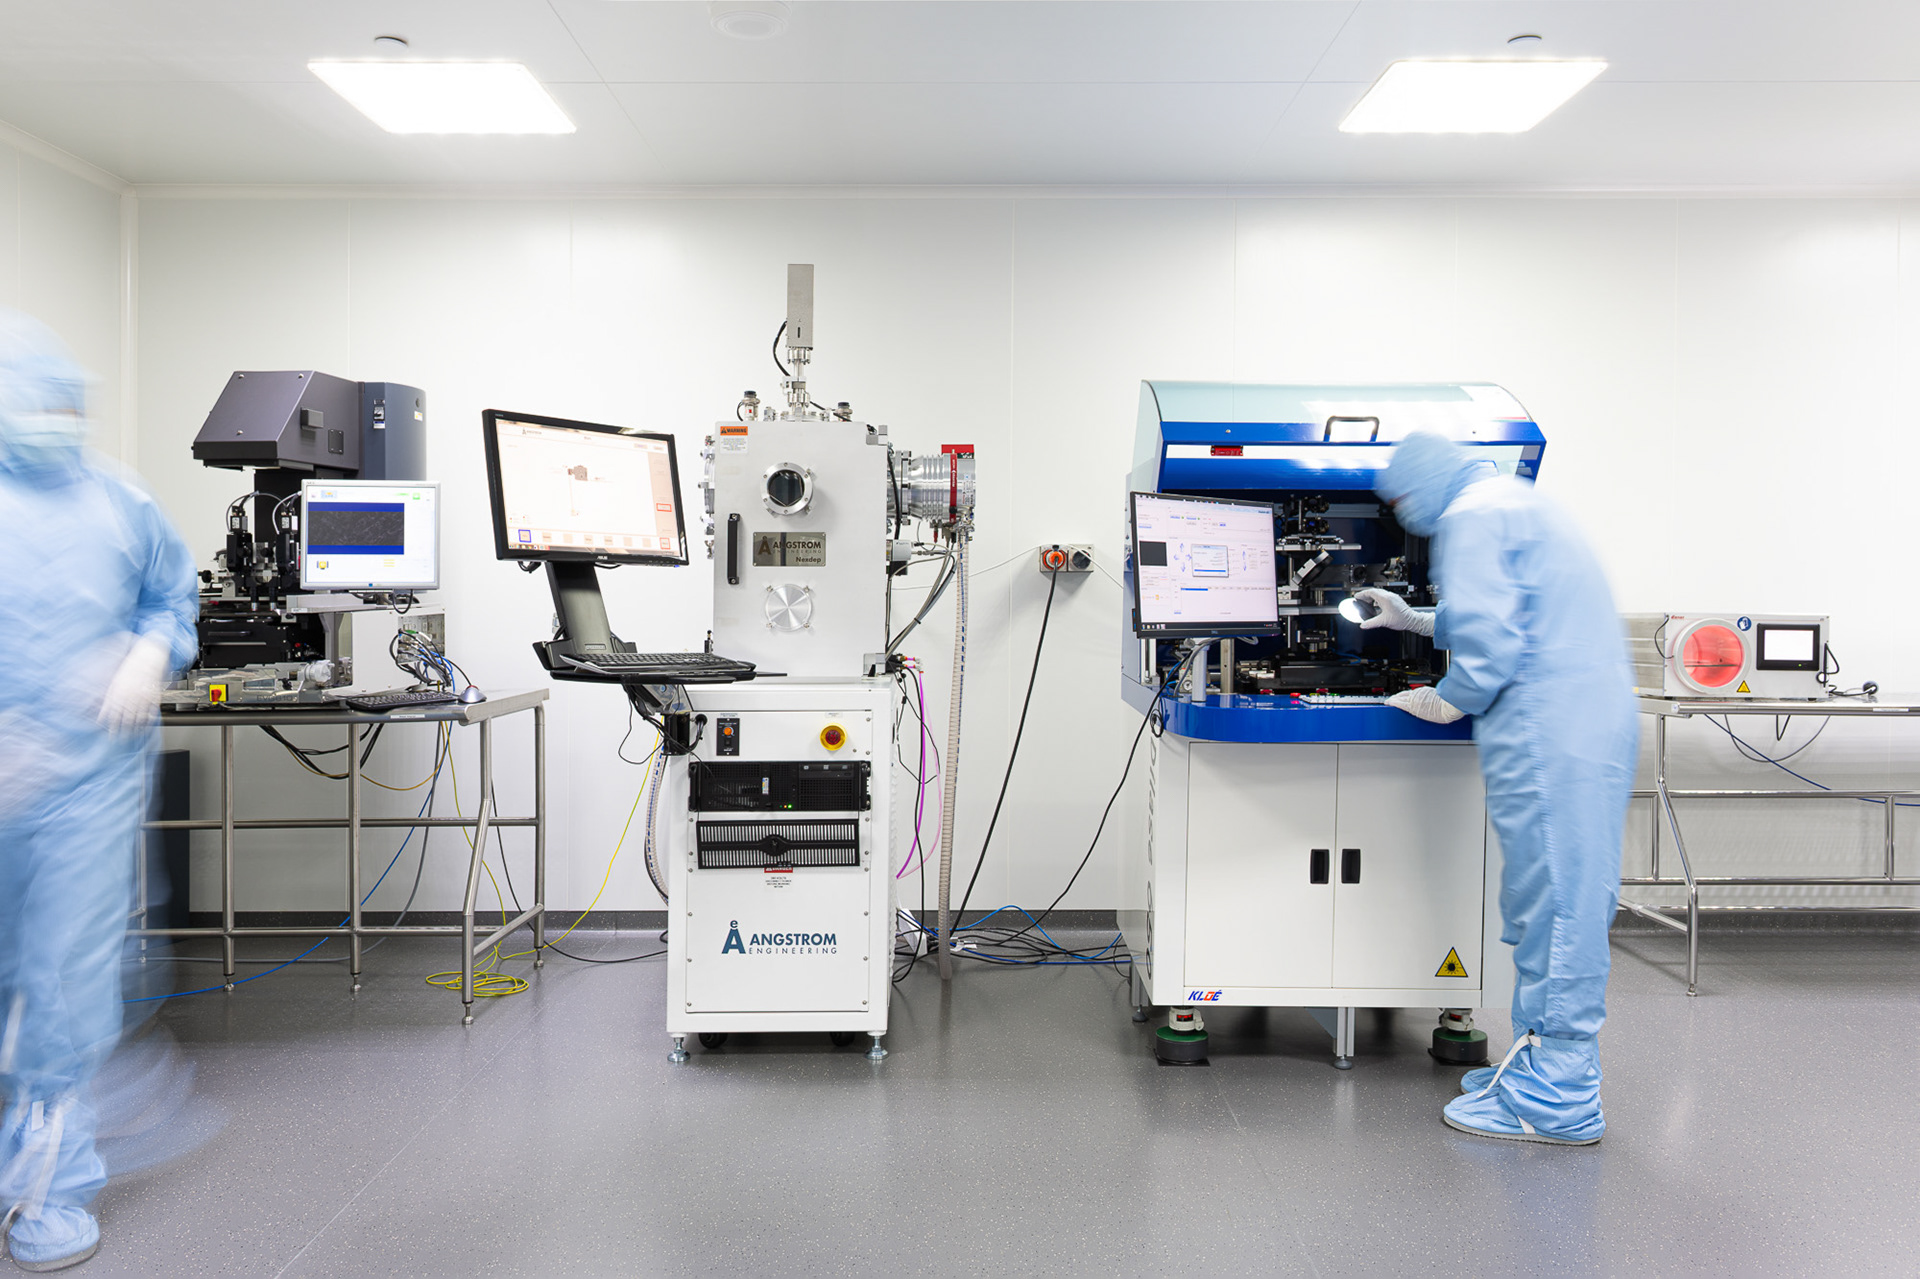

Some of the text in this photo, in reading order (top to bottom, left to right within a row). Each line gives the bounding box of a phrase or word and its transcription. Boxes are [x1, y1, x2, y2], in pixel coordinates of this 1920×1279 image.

[773, 541, 822, 549] AGSTROM
[749, 933, 837, 946] ANGSTROM
[748, 947, 837, 955] ENGINEERING
